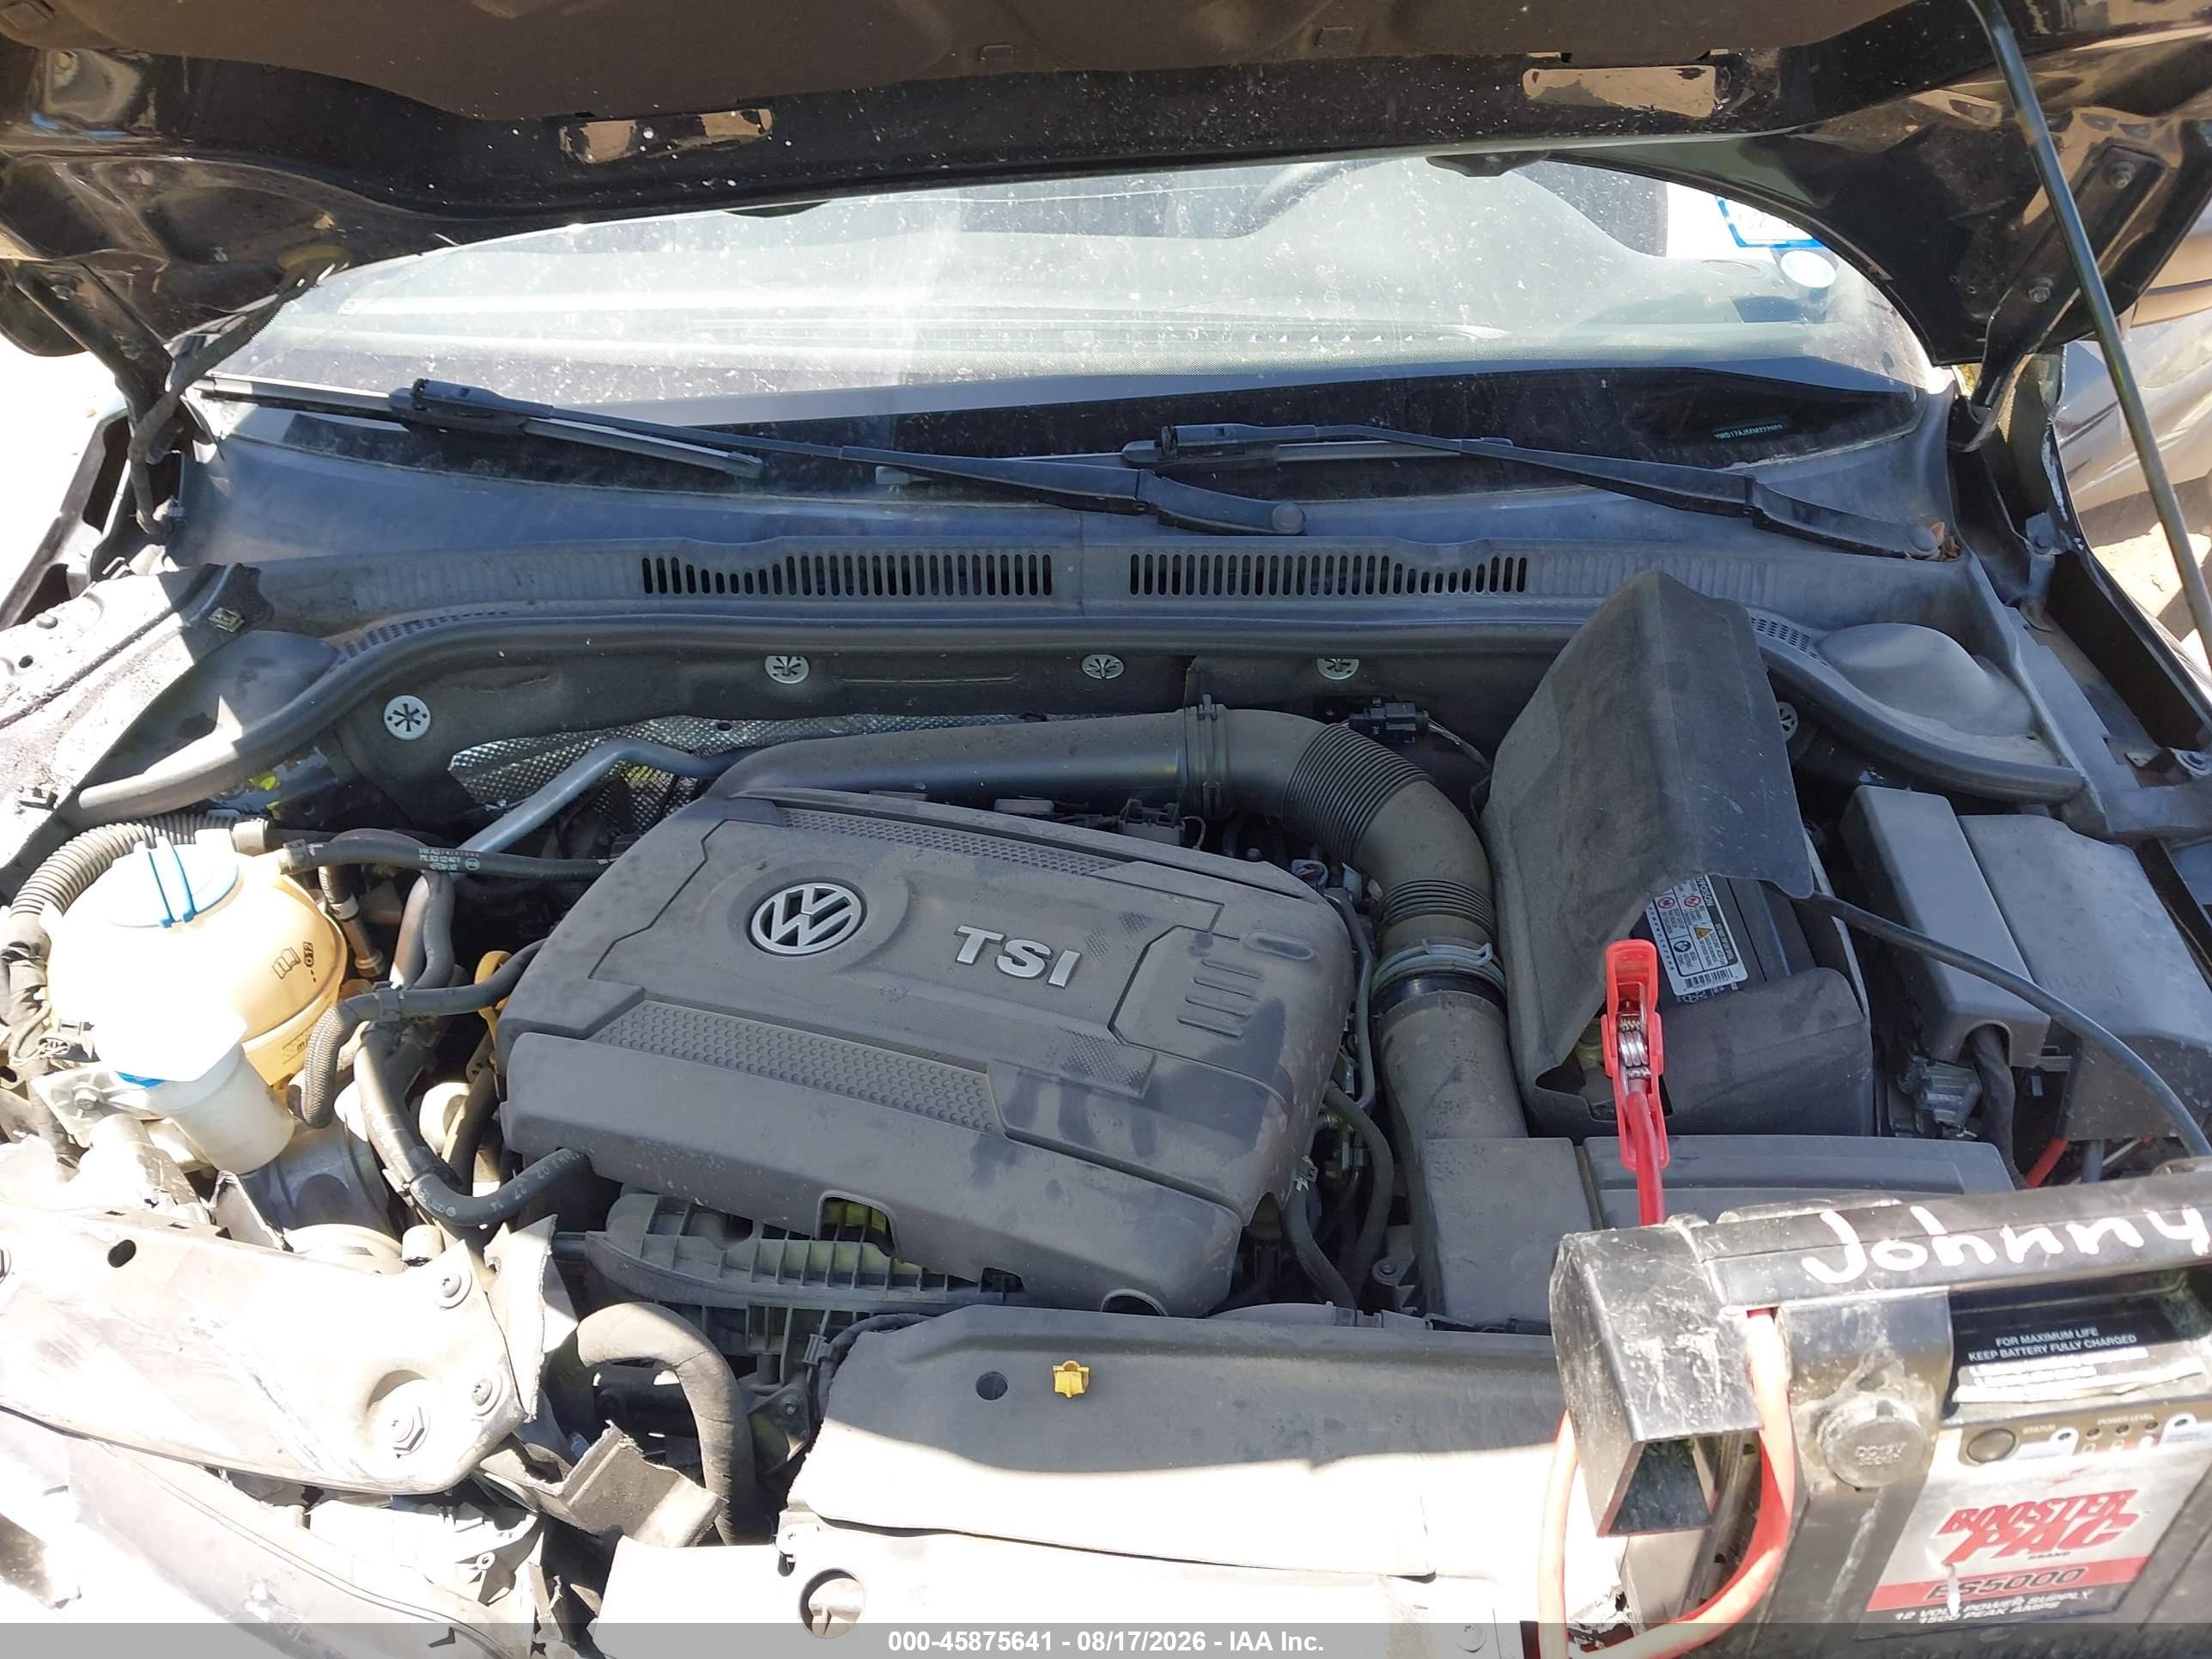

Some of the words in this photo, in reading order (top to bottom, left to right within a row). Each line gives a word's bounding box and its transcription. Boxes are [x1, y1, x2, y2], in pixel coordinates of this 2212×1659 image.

[752, 883, 860, 955] VW
[955, 925, 1082, 988] TSI
[1802, 1205, 2210, 1285] Johnny
[1968, 1349, 1999, 1362] KEEP
[1999, 1345, 2048, 1358] BATTERY
[2050, 1340, 2082, 1352] FULLY
[2083, 1334, 2137, 1349] CHARGED
[1996, 1335, 2020, 1347] FOR
[2020, 1330, 2075, 1345] MAXIMUM
[2075, 1327, 2100, 1339] LIFE
[1936, 1489, 2138, 1535] BOOSTER
[1942, 1513, 2139, 1566] PAC
[1926, 1568, 2087, 1600] ES5000
[1962, 1595, 2025, 1613] POWER
[1962, 1607, 2005, 1620] PEAK
[2009, 1601, 2061, 1613] AMPS
